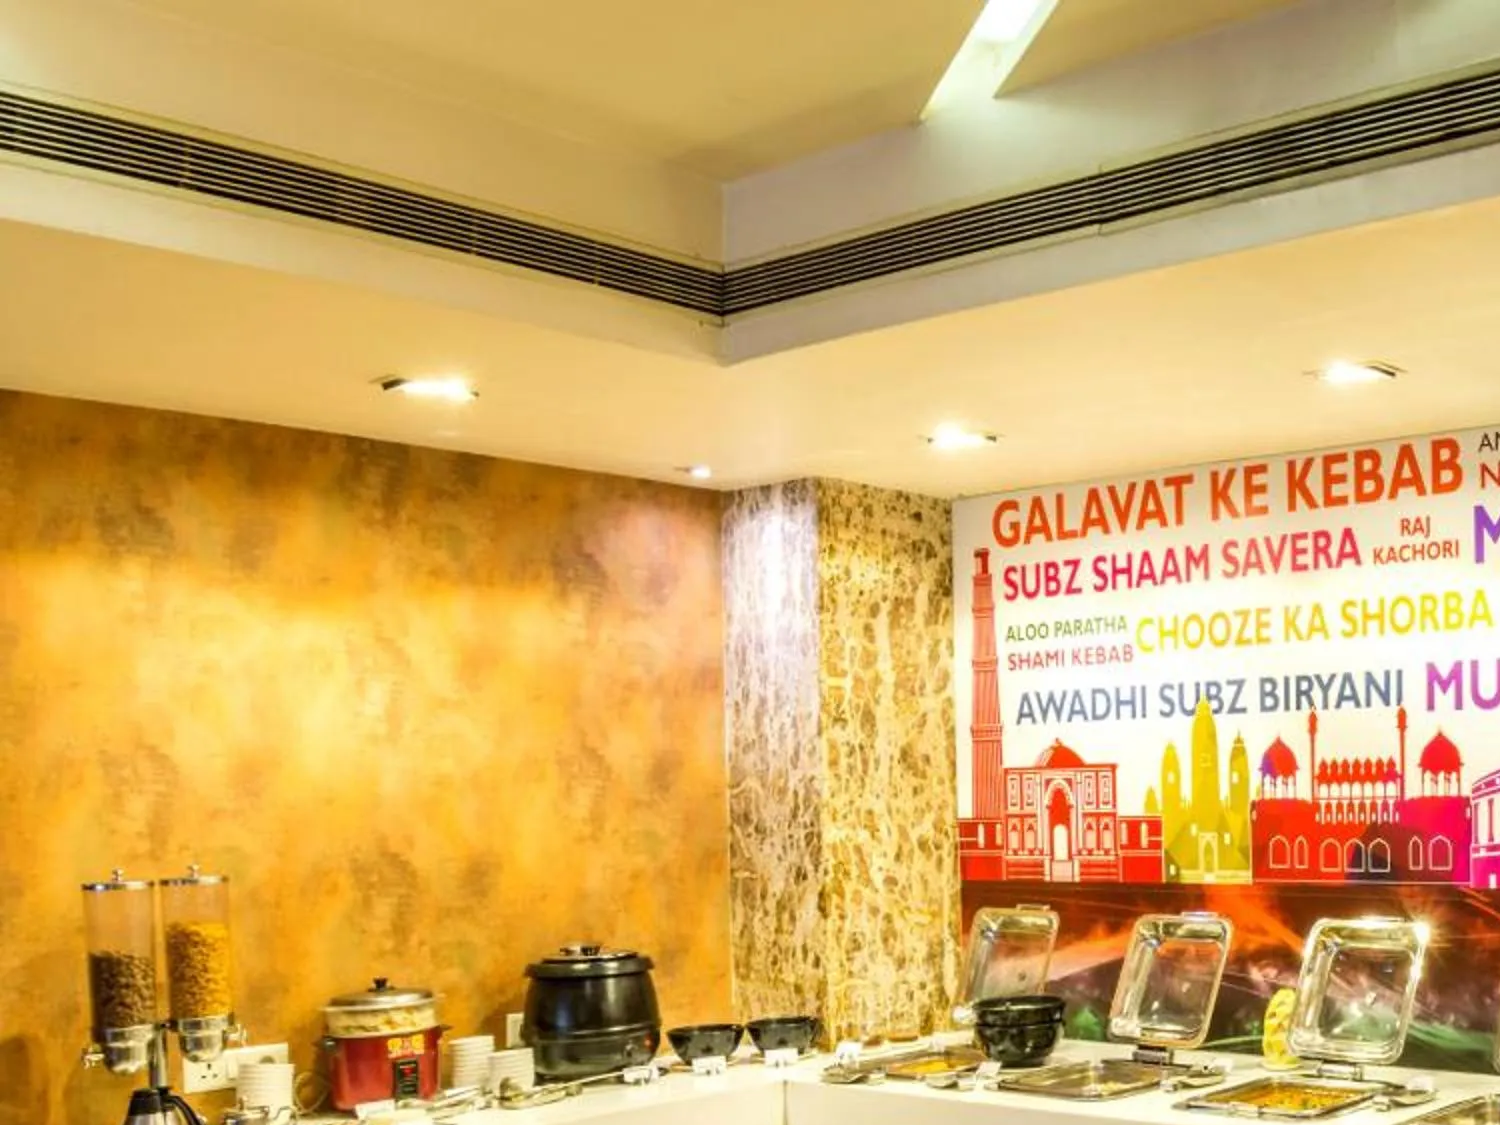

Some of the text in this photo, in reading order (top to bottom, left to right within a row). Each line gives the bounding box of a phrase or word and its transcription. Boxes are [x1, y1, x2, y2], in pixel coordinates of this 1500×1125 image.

[992, 437, 1463, 547] GALAVAT KE KEBAB
[1400, 517, 1431, 538] RAJ
[1002, 527, 1362, 601] SUBZ SHAAM SAVERA
[1373, 541, 1460, 566] KACHORI
[1006, 615, 1128, 642] ALOO PARATHA
[1135, 589, 1494, 653] CHOOZE KA SHORBA
[1007, 644, 1134, 671] SHAMI KEBAB
[1016, 669, 1404, 726] AWADHI SUBZ BIRYANI
